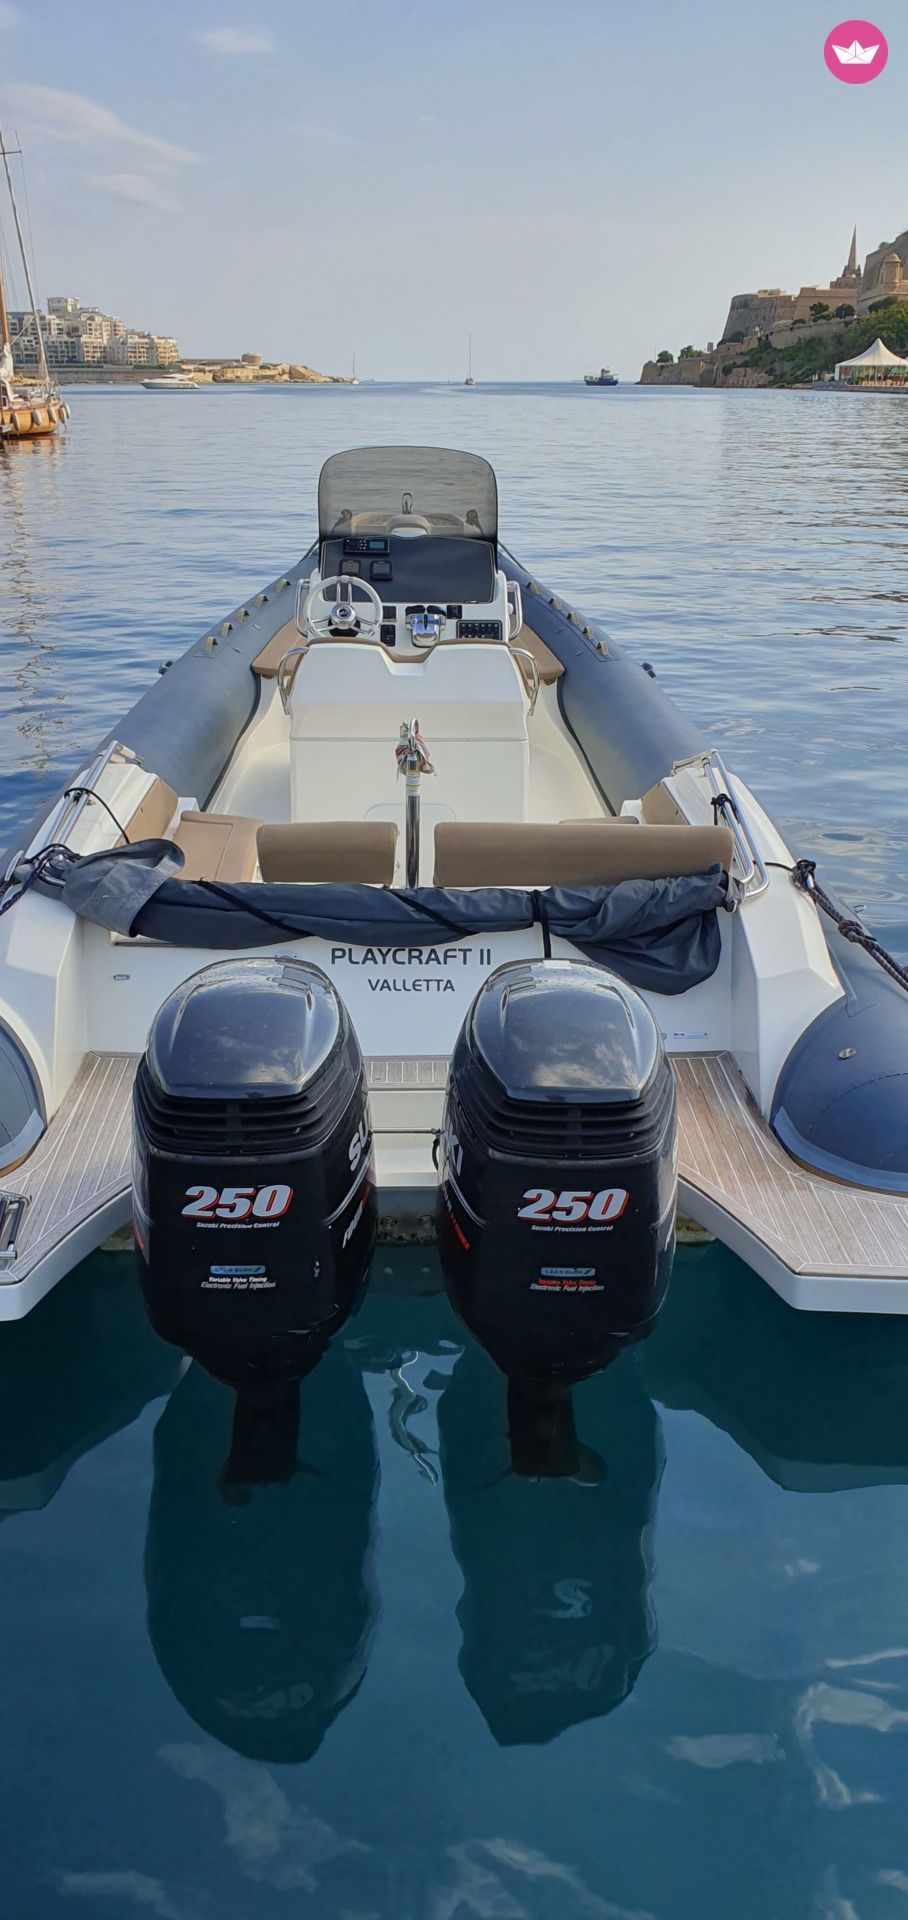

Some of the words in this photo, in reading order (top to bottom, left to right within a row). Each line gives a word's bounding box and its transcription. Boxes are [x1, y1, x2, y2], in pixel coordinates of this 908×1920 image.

[331, 948, 472, 965] PLAYCRAFT
[479, 948, 491, 965] II
[368, 979, 455, 992] VALLETTA
[181, 1184, 294, 1220] 250
[517, 1188, 630, 1223] 250
[200, 1281, 232, 1289] Electronic
